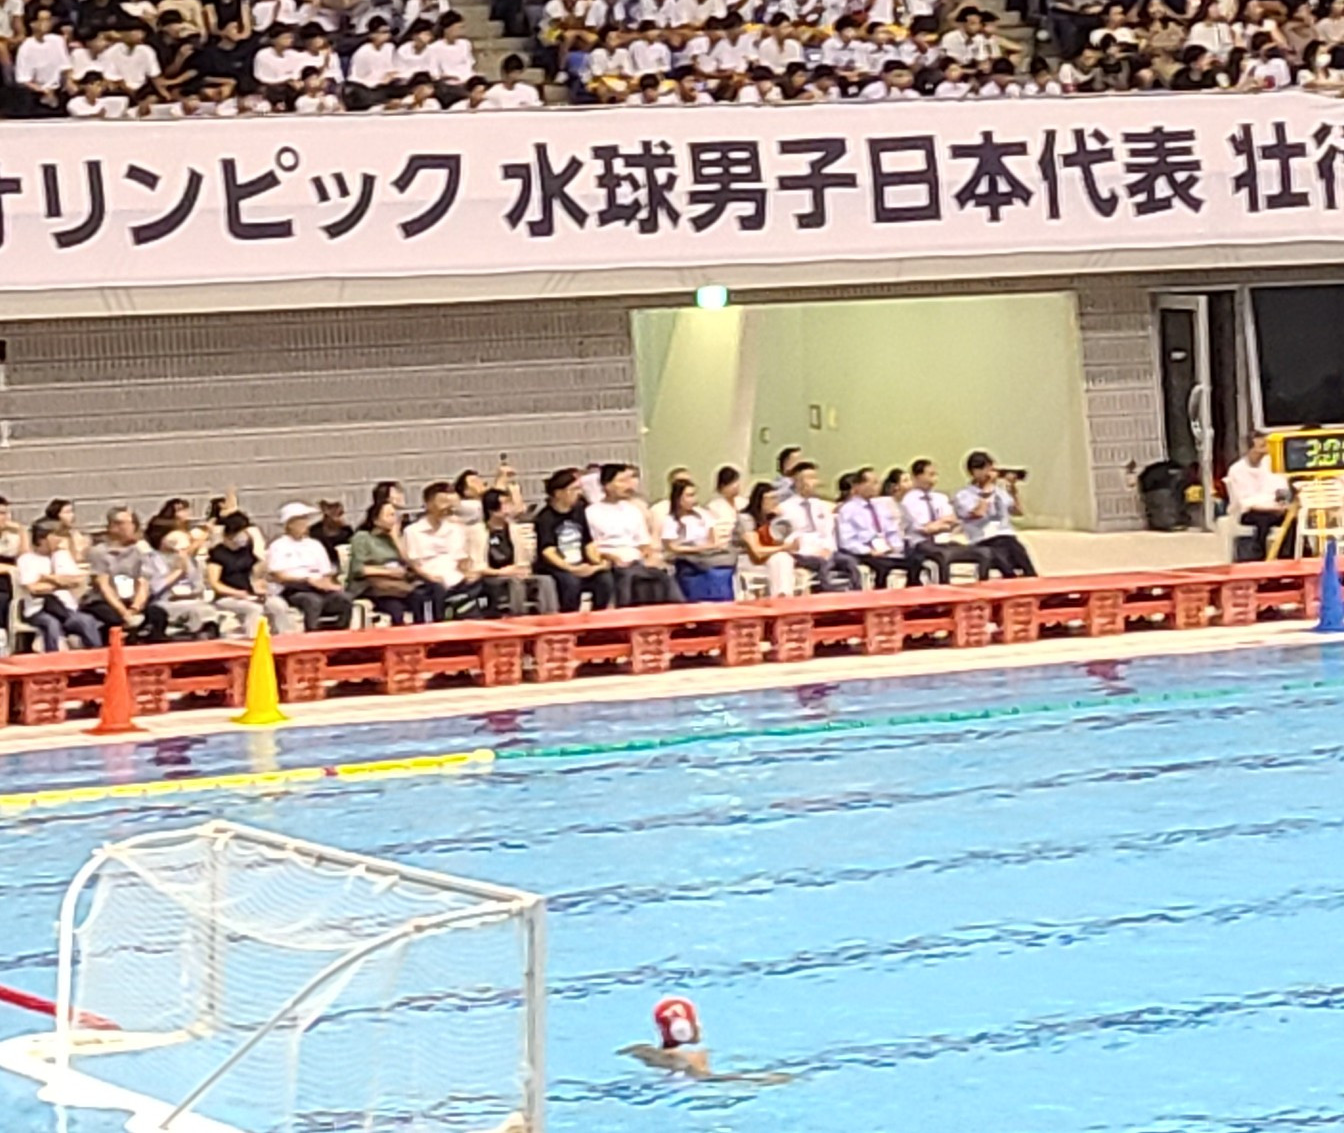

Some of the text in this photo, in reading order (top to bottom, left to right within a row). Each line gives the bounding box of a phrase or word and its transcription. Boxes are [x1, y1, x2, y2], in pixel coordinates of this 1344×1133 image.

[501, 124, 1205, 238] 水球男子日本代表
